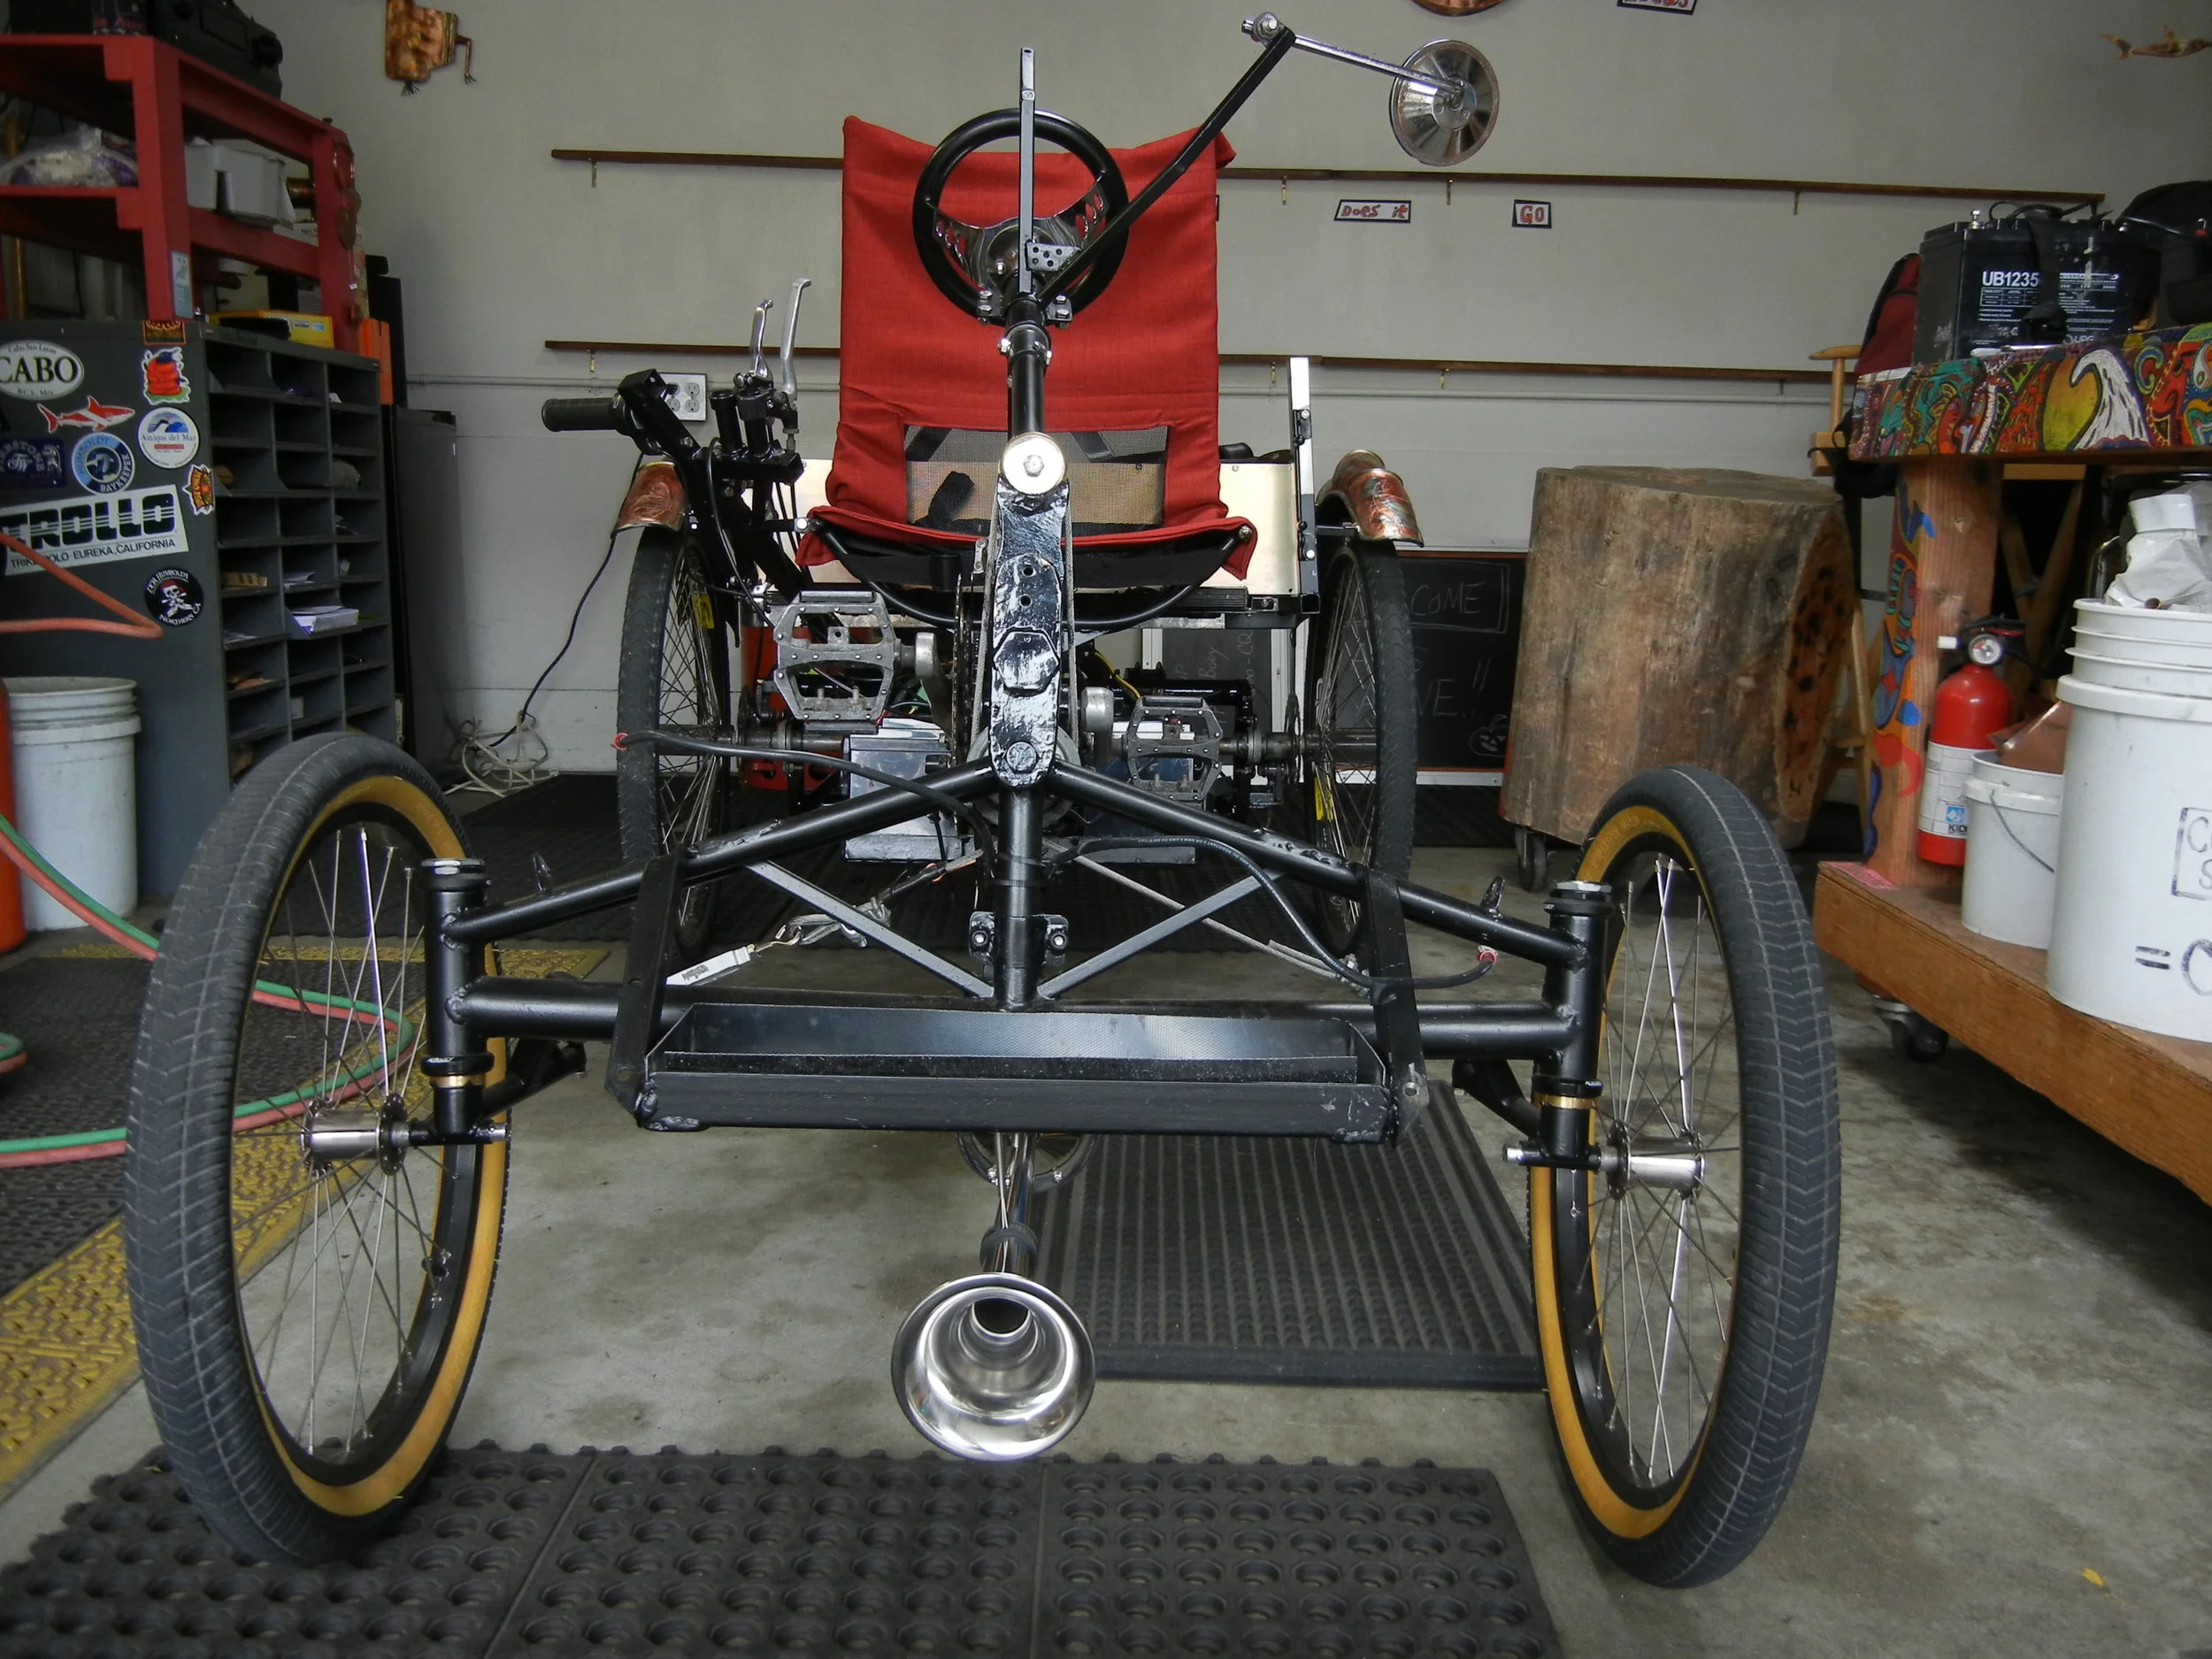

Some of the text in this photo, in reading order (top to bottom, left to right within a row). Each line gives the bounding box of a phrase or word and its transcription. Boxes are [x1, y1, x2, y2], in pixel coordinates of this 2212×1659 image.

[1519, 204, 1545, 225] GO
[0, 356, 79, 384] CABO
[100, 453, 131, 493] BAYKEEPER
[116, 538, 176, 555] CALIFORNIA
